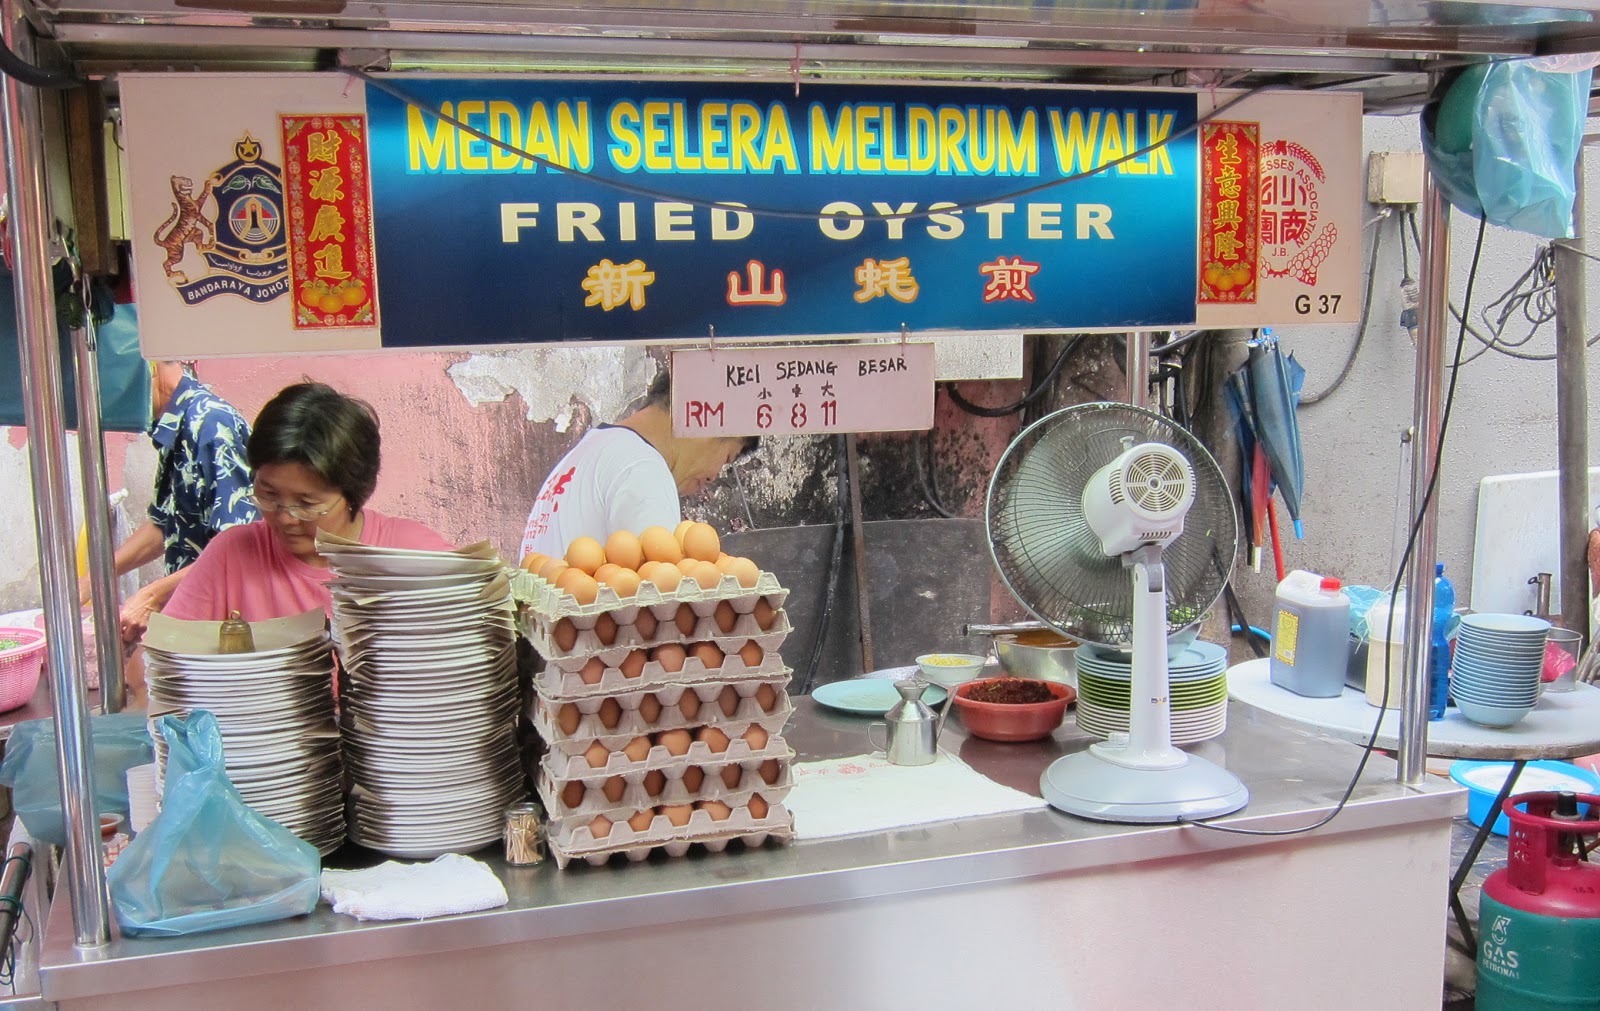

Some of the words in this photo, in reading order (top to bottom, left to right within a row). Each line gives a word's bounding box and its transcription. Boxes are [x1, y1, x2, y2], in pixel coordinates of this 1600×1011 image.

[405, 98, 594, 174] MEDAN
[606, 98, 801, 174] SELERA
[808, 101, 1039, 177] MELDRUM
[1046, 106, 1177, 178] WALK
[307, 129, 352, 280] 財源廣進
[1212, 132, 1245, 261] 生意興隆
[1295, 168, 1319, 249] ASSOCIATION
[500, 201, 755, 242] FRIED
[818, 201, 1115, 240] OYSTER
[1272, 247, 1289, 257] J.B.
[187, 279, 251, 301] BANDARAYA
[1294, 294, 1311, 315] G
[1318, 294, 1342, 315] 37
[776, 360, 838, 381] SEDANG
[858, 357, 907, 377] BESAR
[685, 401, 724, 427] RM
[756, 403, 773, 429] 6
[791, 403, 807, 428] 8
[820, 400, 837, 426] 11
[1483, 940, 1519, 969] GAS
